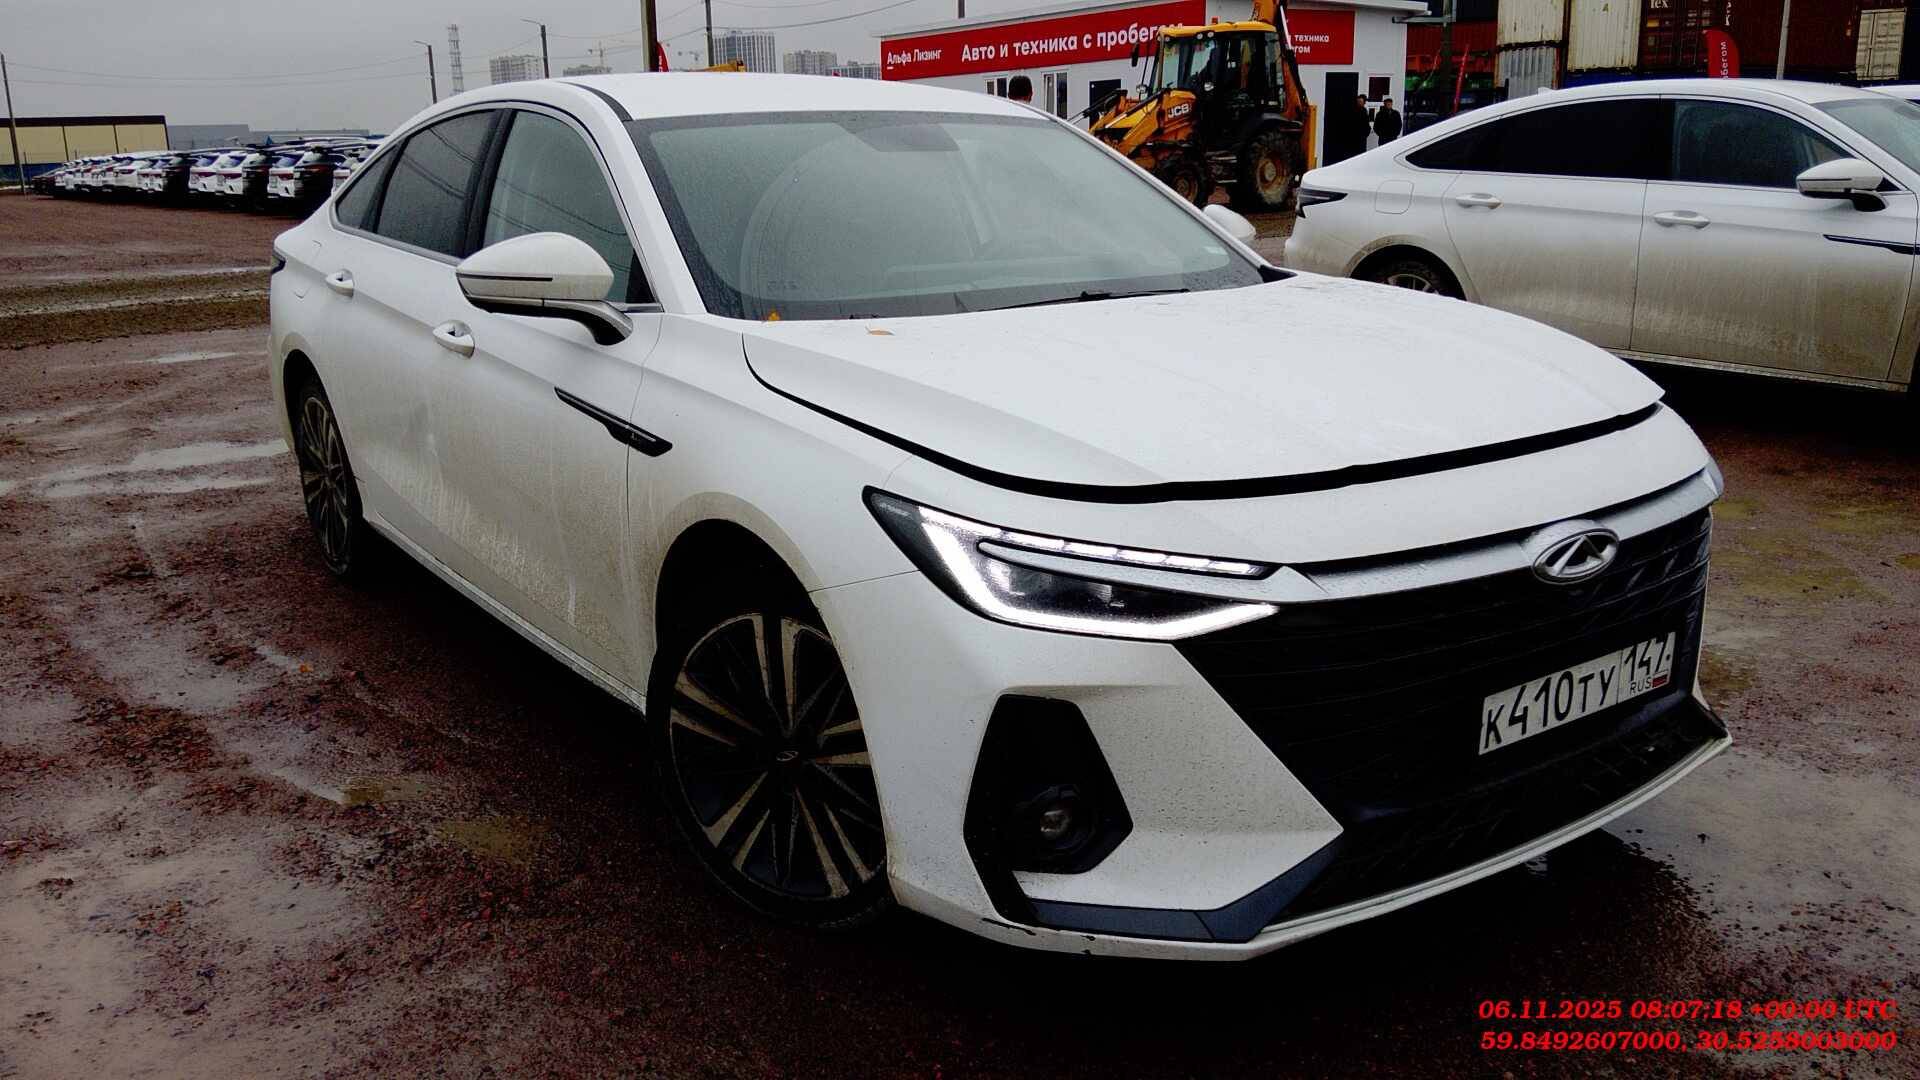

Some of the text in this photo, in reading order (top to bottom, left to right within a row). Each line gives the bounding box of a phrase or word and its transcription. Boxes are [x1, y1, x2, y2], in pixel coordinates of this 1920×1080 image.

[961, 23, 1183, 62] Авто и техника с пробег
[886, 47, 942, 70] Альфа Лизинг
[1167, 103, 1190, 118] JCB
[1484, 635, 1667, 749] К410ТУ 147
[1628, 676, 1653, 695] RUS
